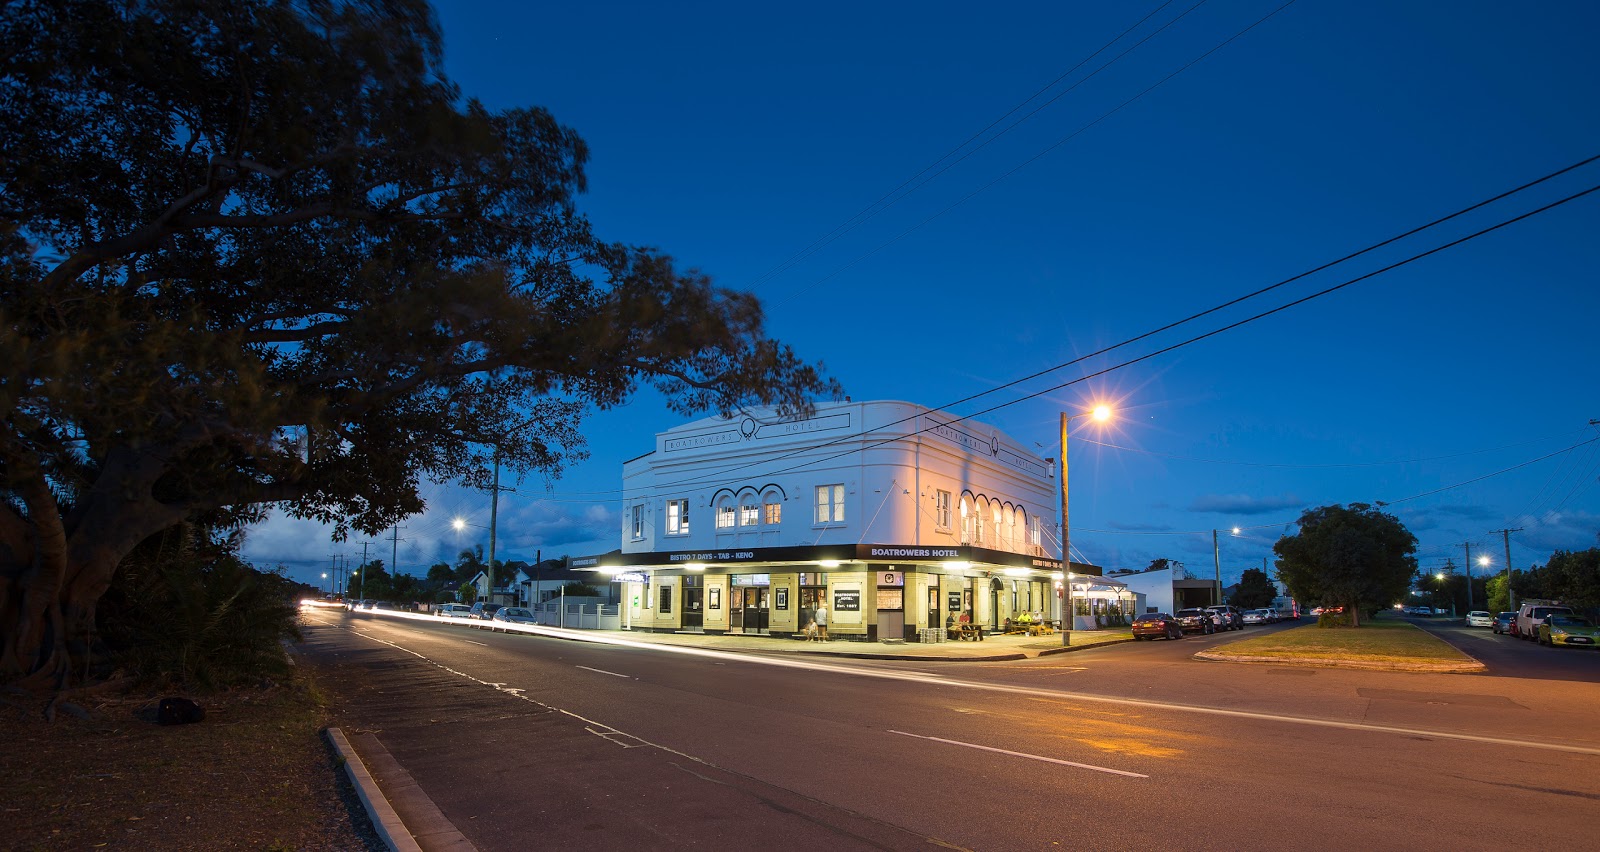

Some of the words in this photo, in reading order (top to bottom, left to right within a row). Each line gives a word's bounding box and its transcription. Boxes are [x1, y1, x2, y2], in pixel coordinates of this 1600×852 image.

[670, 433, 732, 449] BOATROWERS
[785, 421, 821, 433] HOTEL
[718, 552, 730, 560] TAB
[735, 551, 754, 559] KENO
[871, 548, 930, 557] BOATROWERS
[932, 549, 959, 557] HOTEL
